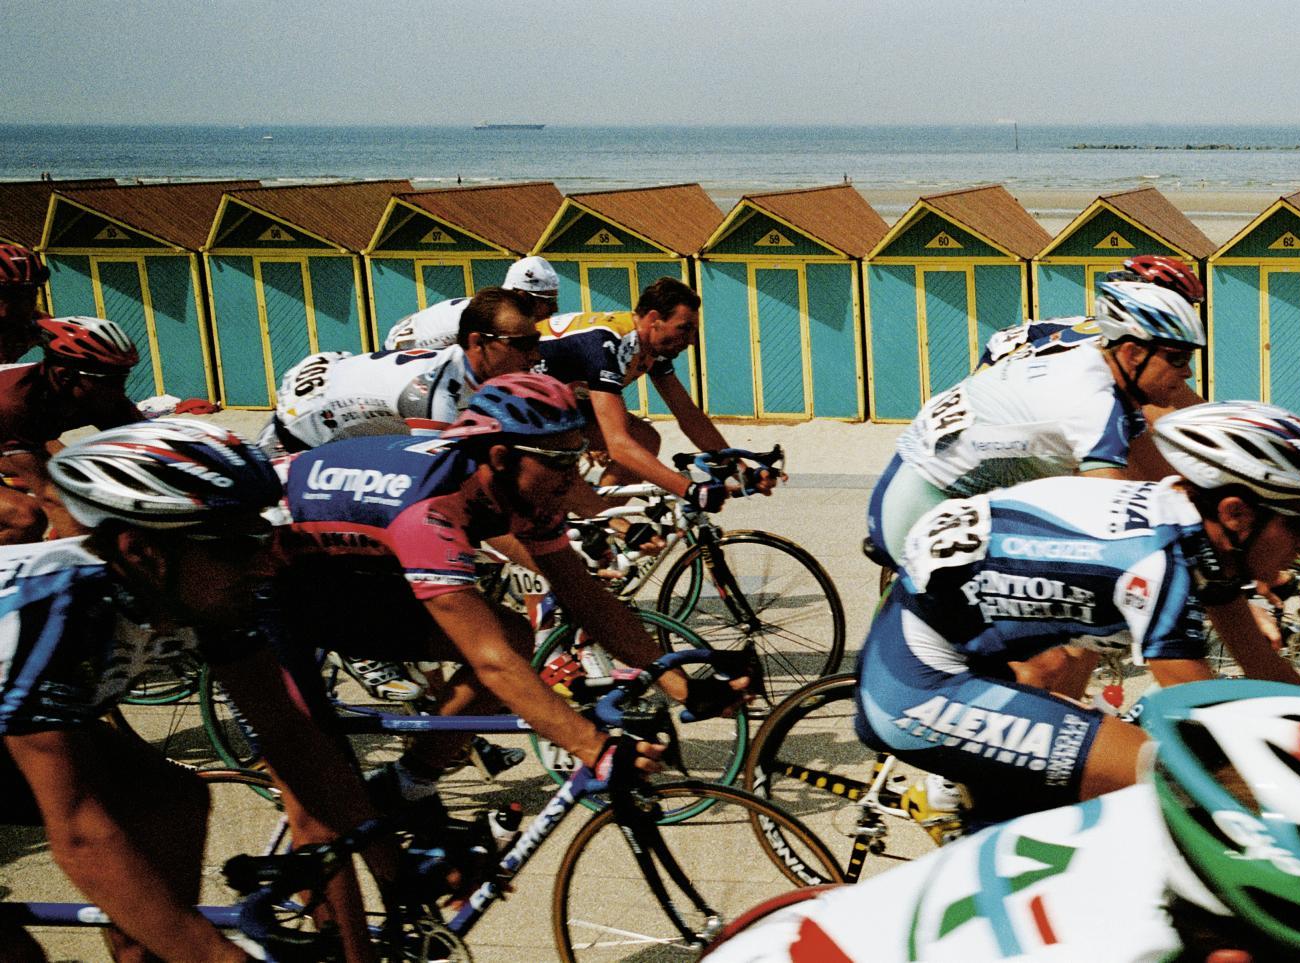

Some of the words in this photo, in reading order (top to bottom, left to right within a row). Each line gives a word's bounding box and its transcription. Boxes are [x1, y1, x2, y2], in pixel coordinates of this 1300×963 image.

[432, 231, 442, 242] 57
[769, 234, 781, 244] 59
[938, 236, 950, 246] 60
[1110, 236, 1119, 247] 61
[1283, 236, 1295, 247] 62
[294, 355, 331, 397] 106
[512, 573, 543, 593] 106
[903, 695, 1054, 758] ALEXIA
[469, 780, 576, 911] FODRIEST
